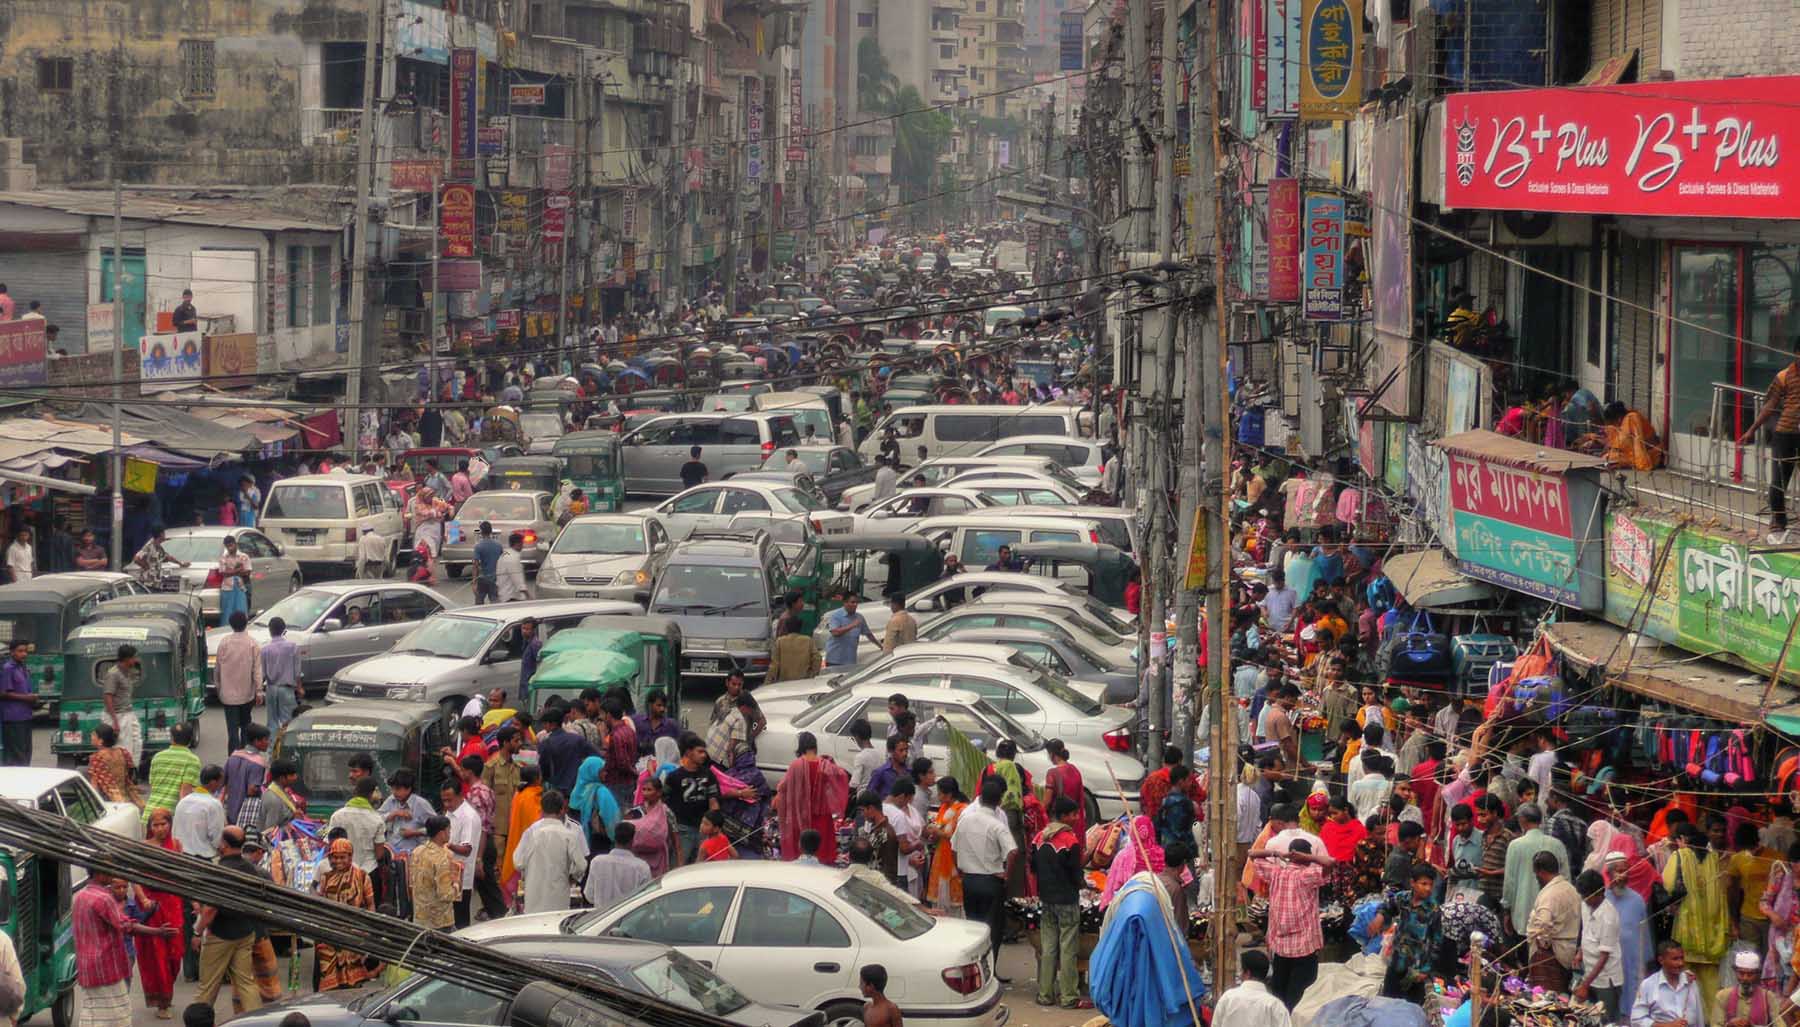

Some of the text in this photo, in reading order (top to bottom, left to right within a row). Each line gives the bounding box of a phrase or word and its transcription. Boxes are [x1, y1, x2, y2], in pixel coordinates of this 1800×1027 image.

[1556, 122, 1609, 172] Plus
[1714, 117, 1778, 173] Plus
[1528, 182, 1549, 193] Exclusive
[1550, 182, 1566, 194] Sarees
[1572, 183, 1585, 195] Dress
[1585, 183, 1609, 196] Materials
[1679, 182, 1704, 195] Exclusive
[1706, 182, 1726, 195] Sarees
[1733, 183, 1749, 195] Dress
[1750, 183, 1779, 196] Materials
[1453, 455, 1564, 526] নূর ম্যানসন
[1460, 520, 1508, 564] শপিং
[1511, 536, 1572, 584] সেন্টার
